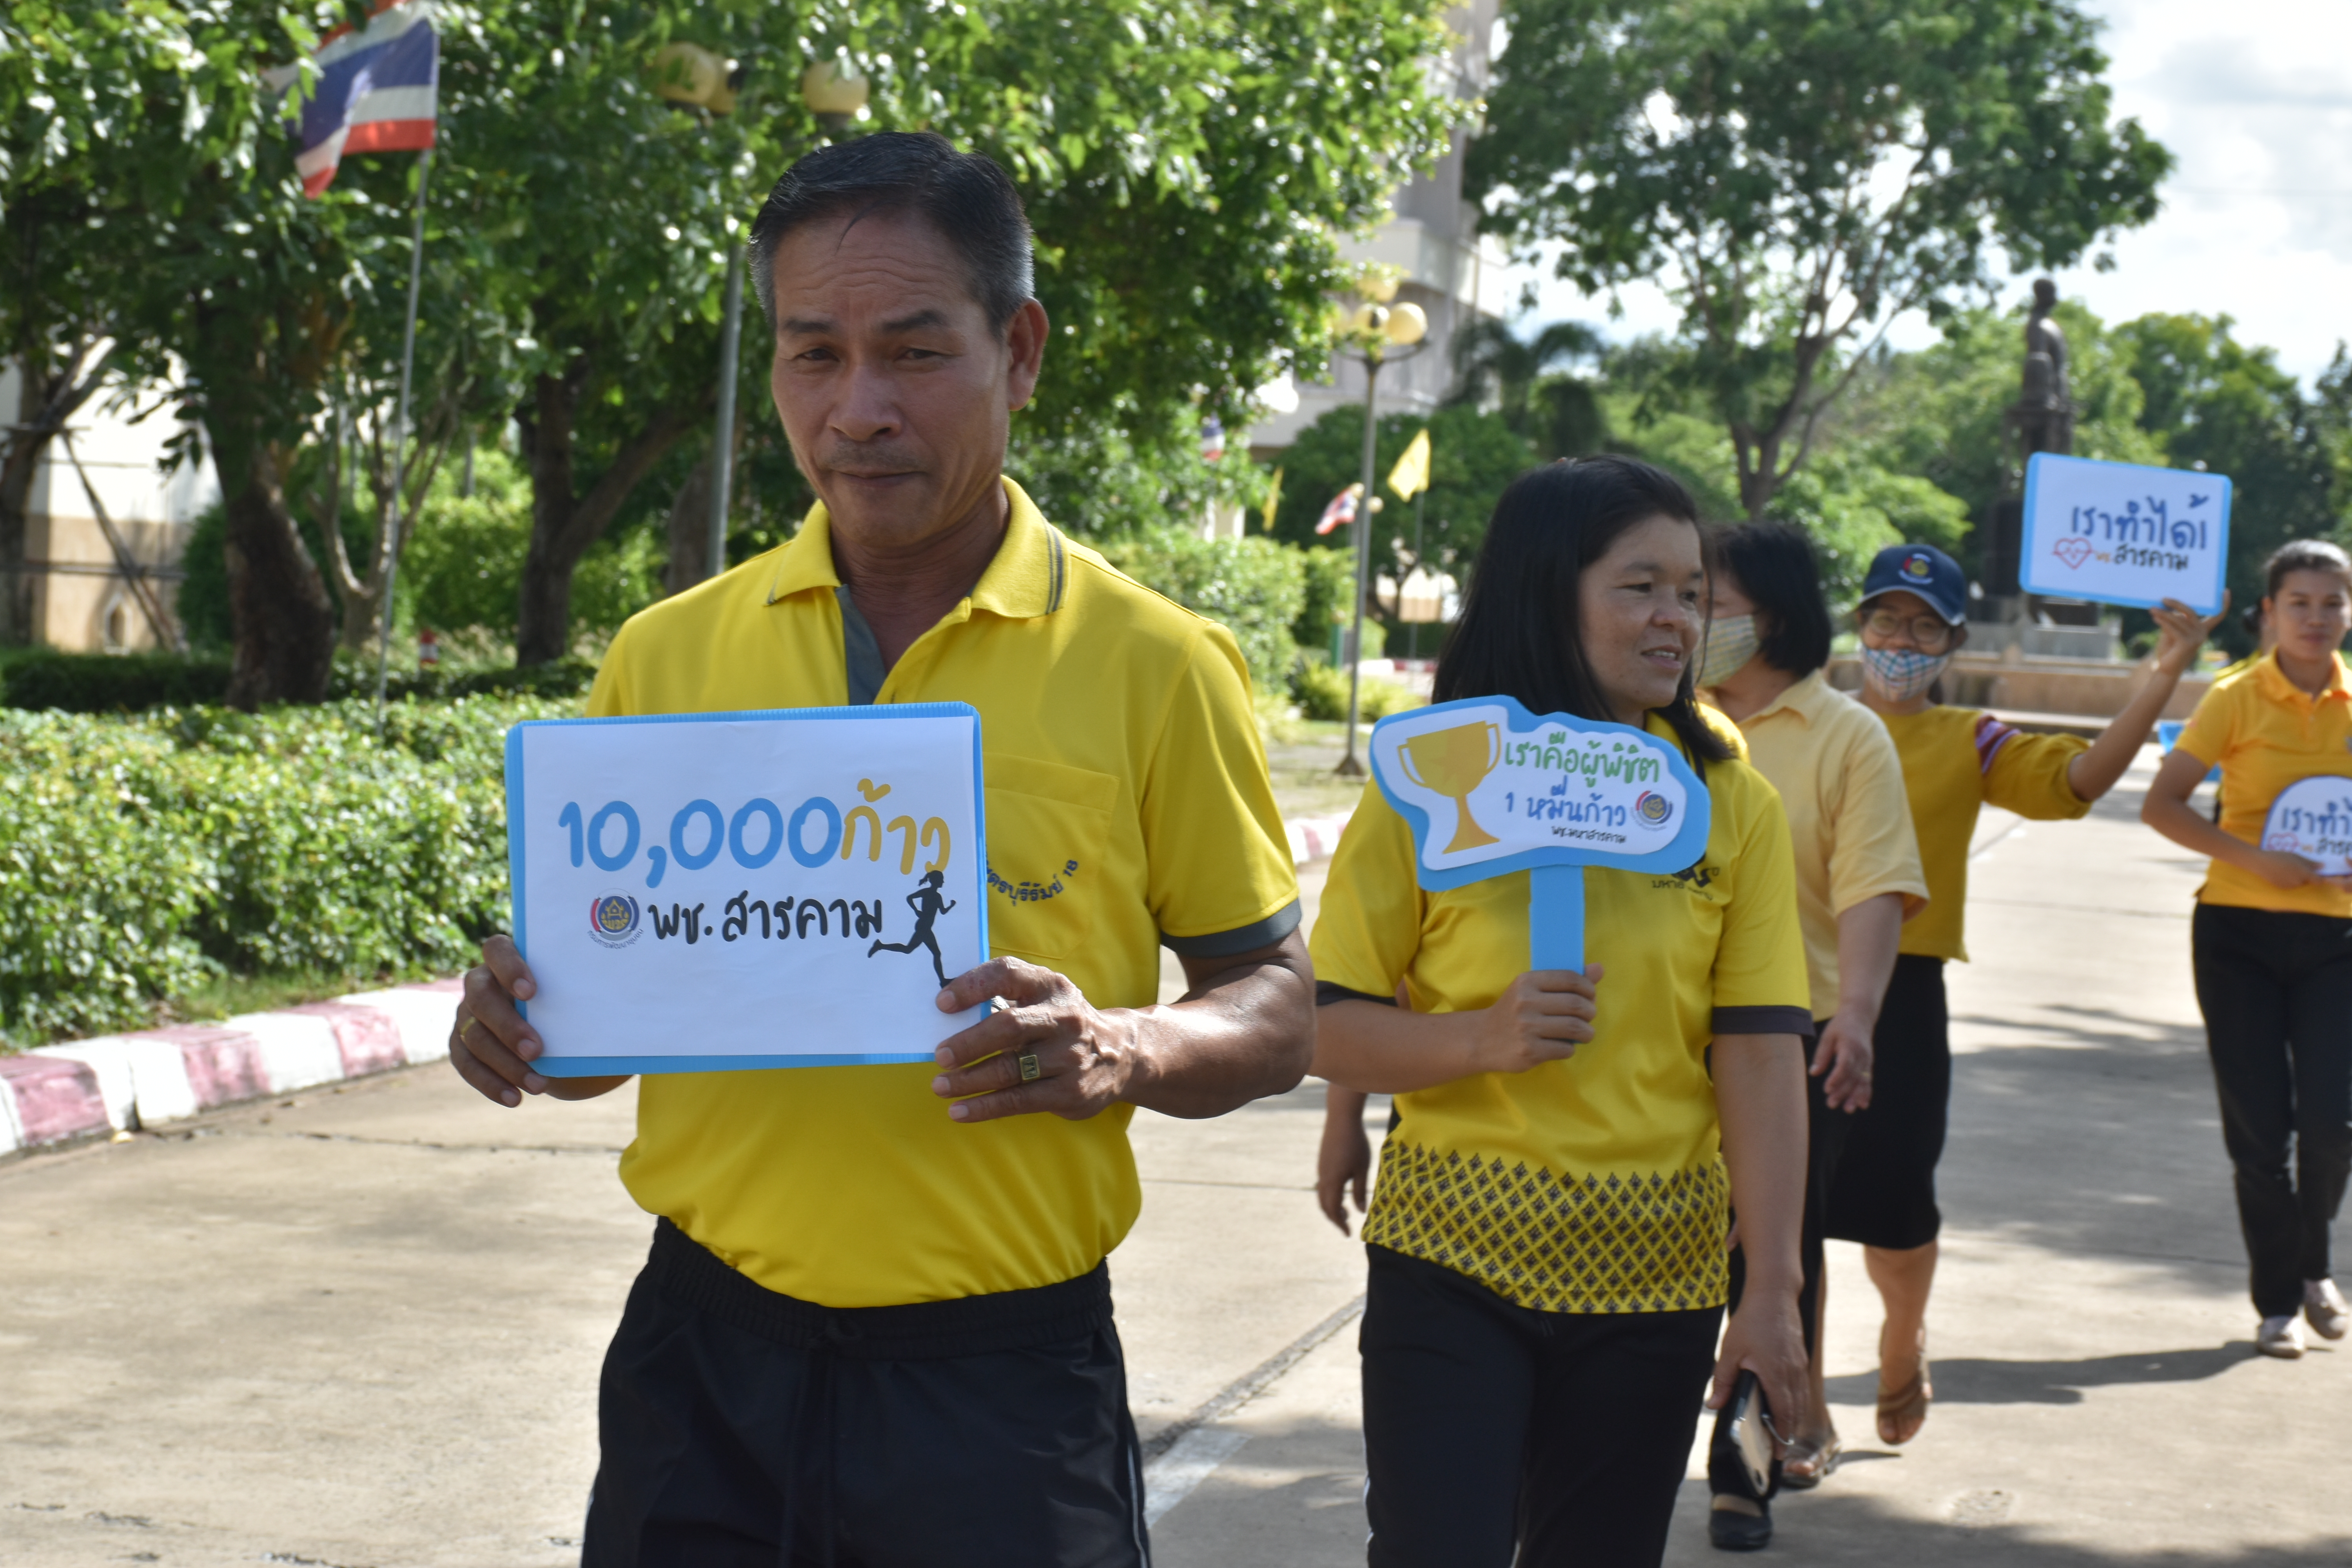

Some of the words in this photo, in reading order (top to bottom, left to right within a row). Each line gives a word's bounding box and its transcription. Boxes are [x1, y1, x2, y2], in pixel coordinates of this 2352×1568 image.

[1504, 731, 1659, 788] เราคือผู้พิชิต
[1505, 792, 1514, 813] 1
[1526, 775, 1626, 826] หมื่นก้าว
